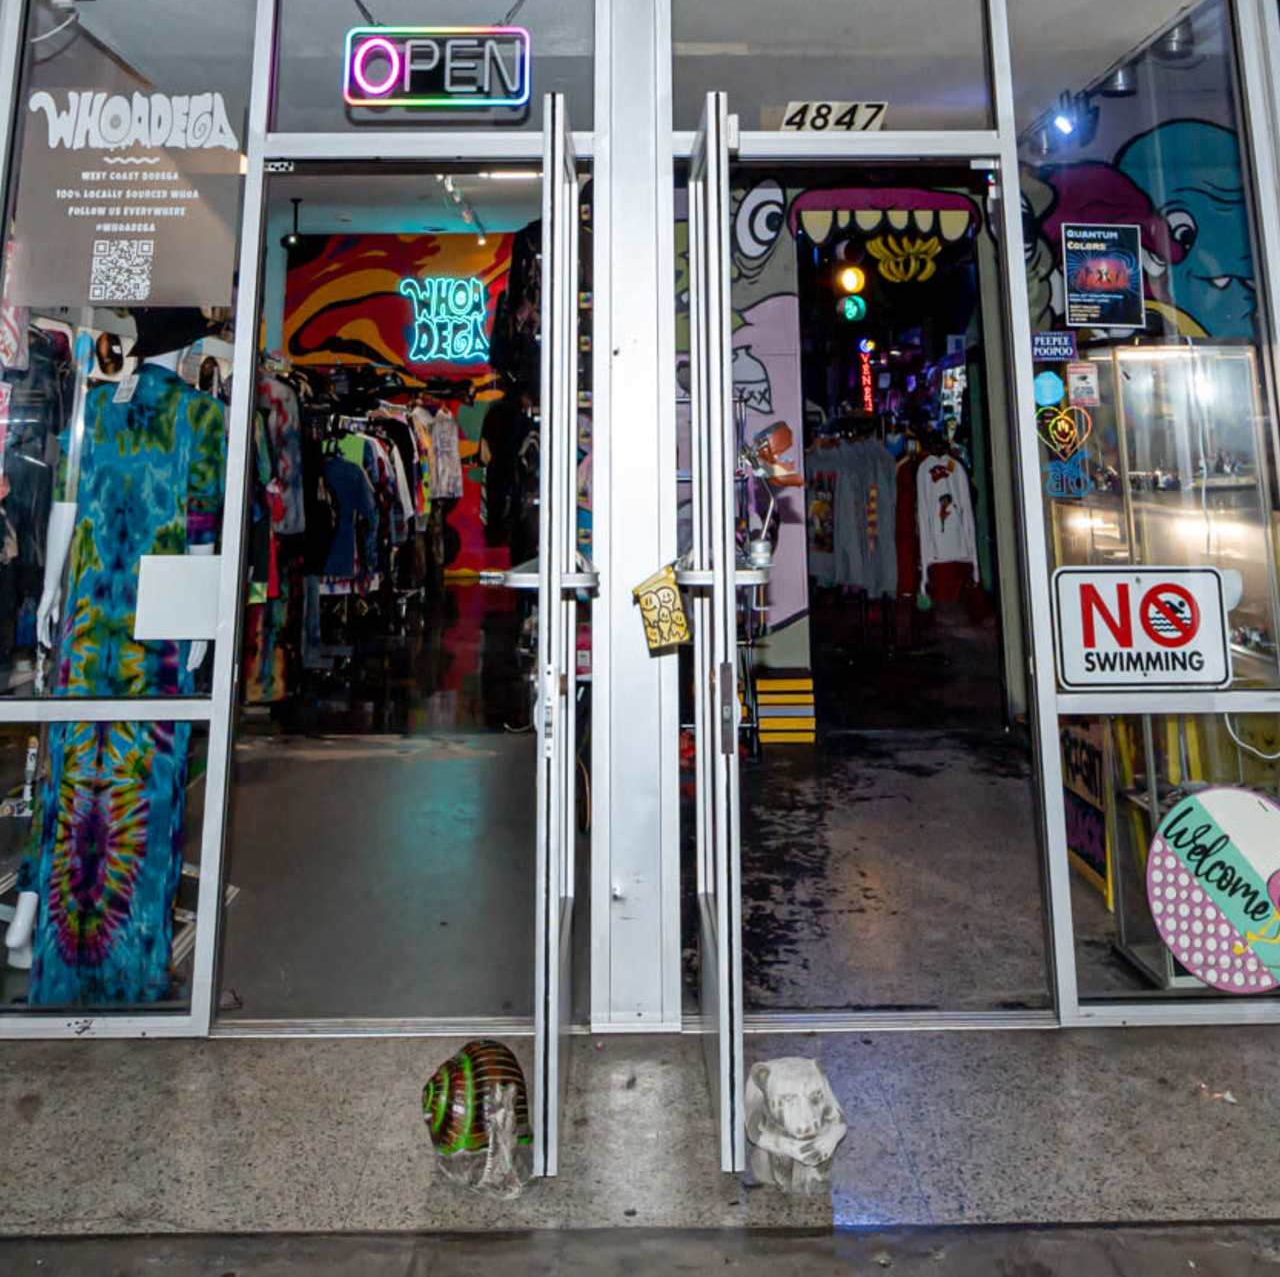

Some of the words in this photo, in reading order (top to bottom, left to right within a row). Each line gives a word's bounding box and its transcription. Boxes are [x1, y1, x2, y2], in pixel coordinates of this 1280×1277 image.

[353, 37, 523, 95] OPEN
[28, 91, 239, 151] WHOADEGA
[784, 103, 885, 131] 4847
[81, 171, 107, 181] WEST
[110, 171, 139, 181] COAST
[84, 189, 122, 199] LOCALLY
[126, 189, 168, 199] SOURCED
[68, 206, 106, 217] FOLLOW
[108, 206, 121, 216] US
[123, 206, 187, 216] EVERYWHERE
[1066, 229, 1118, 239] QUANTUM
[1066, 241, 1107, 251] COLORS
[400, 278, 485, 318] WHOA
[409, 317, 490, 360] DEGA
[1033, 335, 1071, 347] PEEPEE
[1033, 346, 1073, 357] POOPOO
[1079, 583, 1201, 649] NO
[1084, 650, 1205, 673] SWIMMING
[1162, 807, 1272, 922] Welcome
